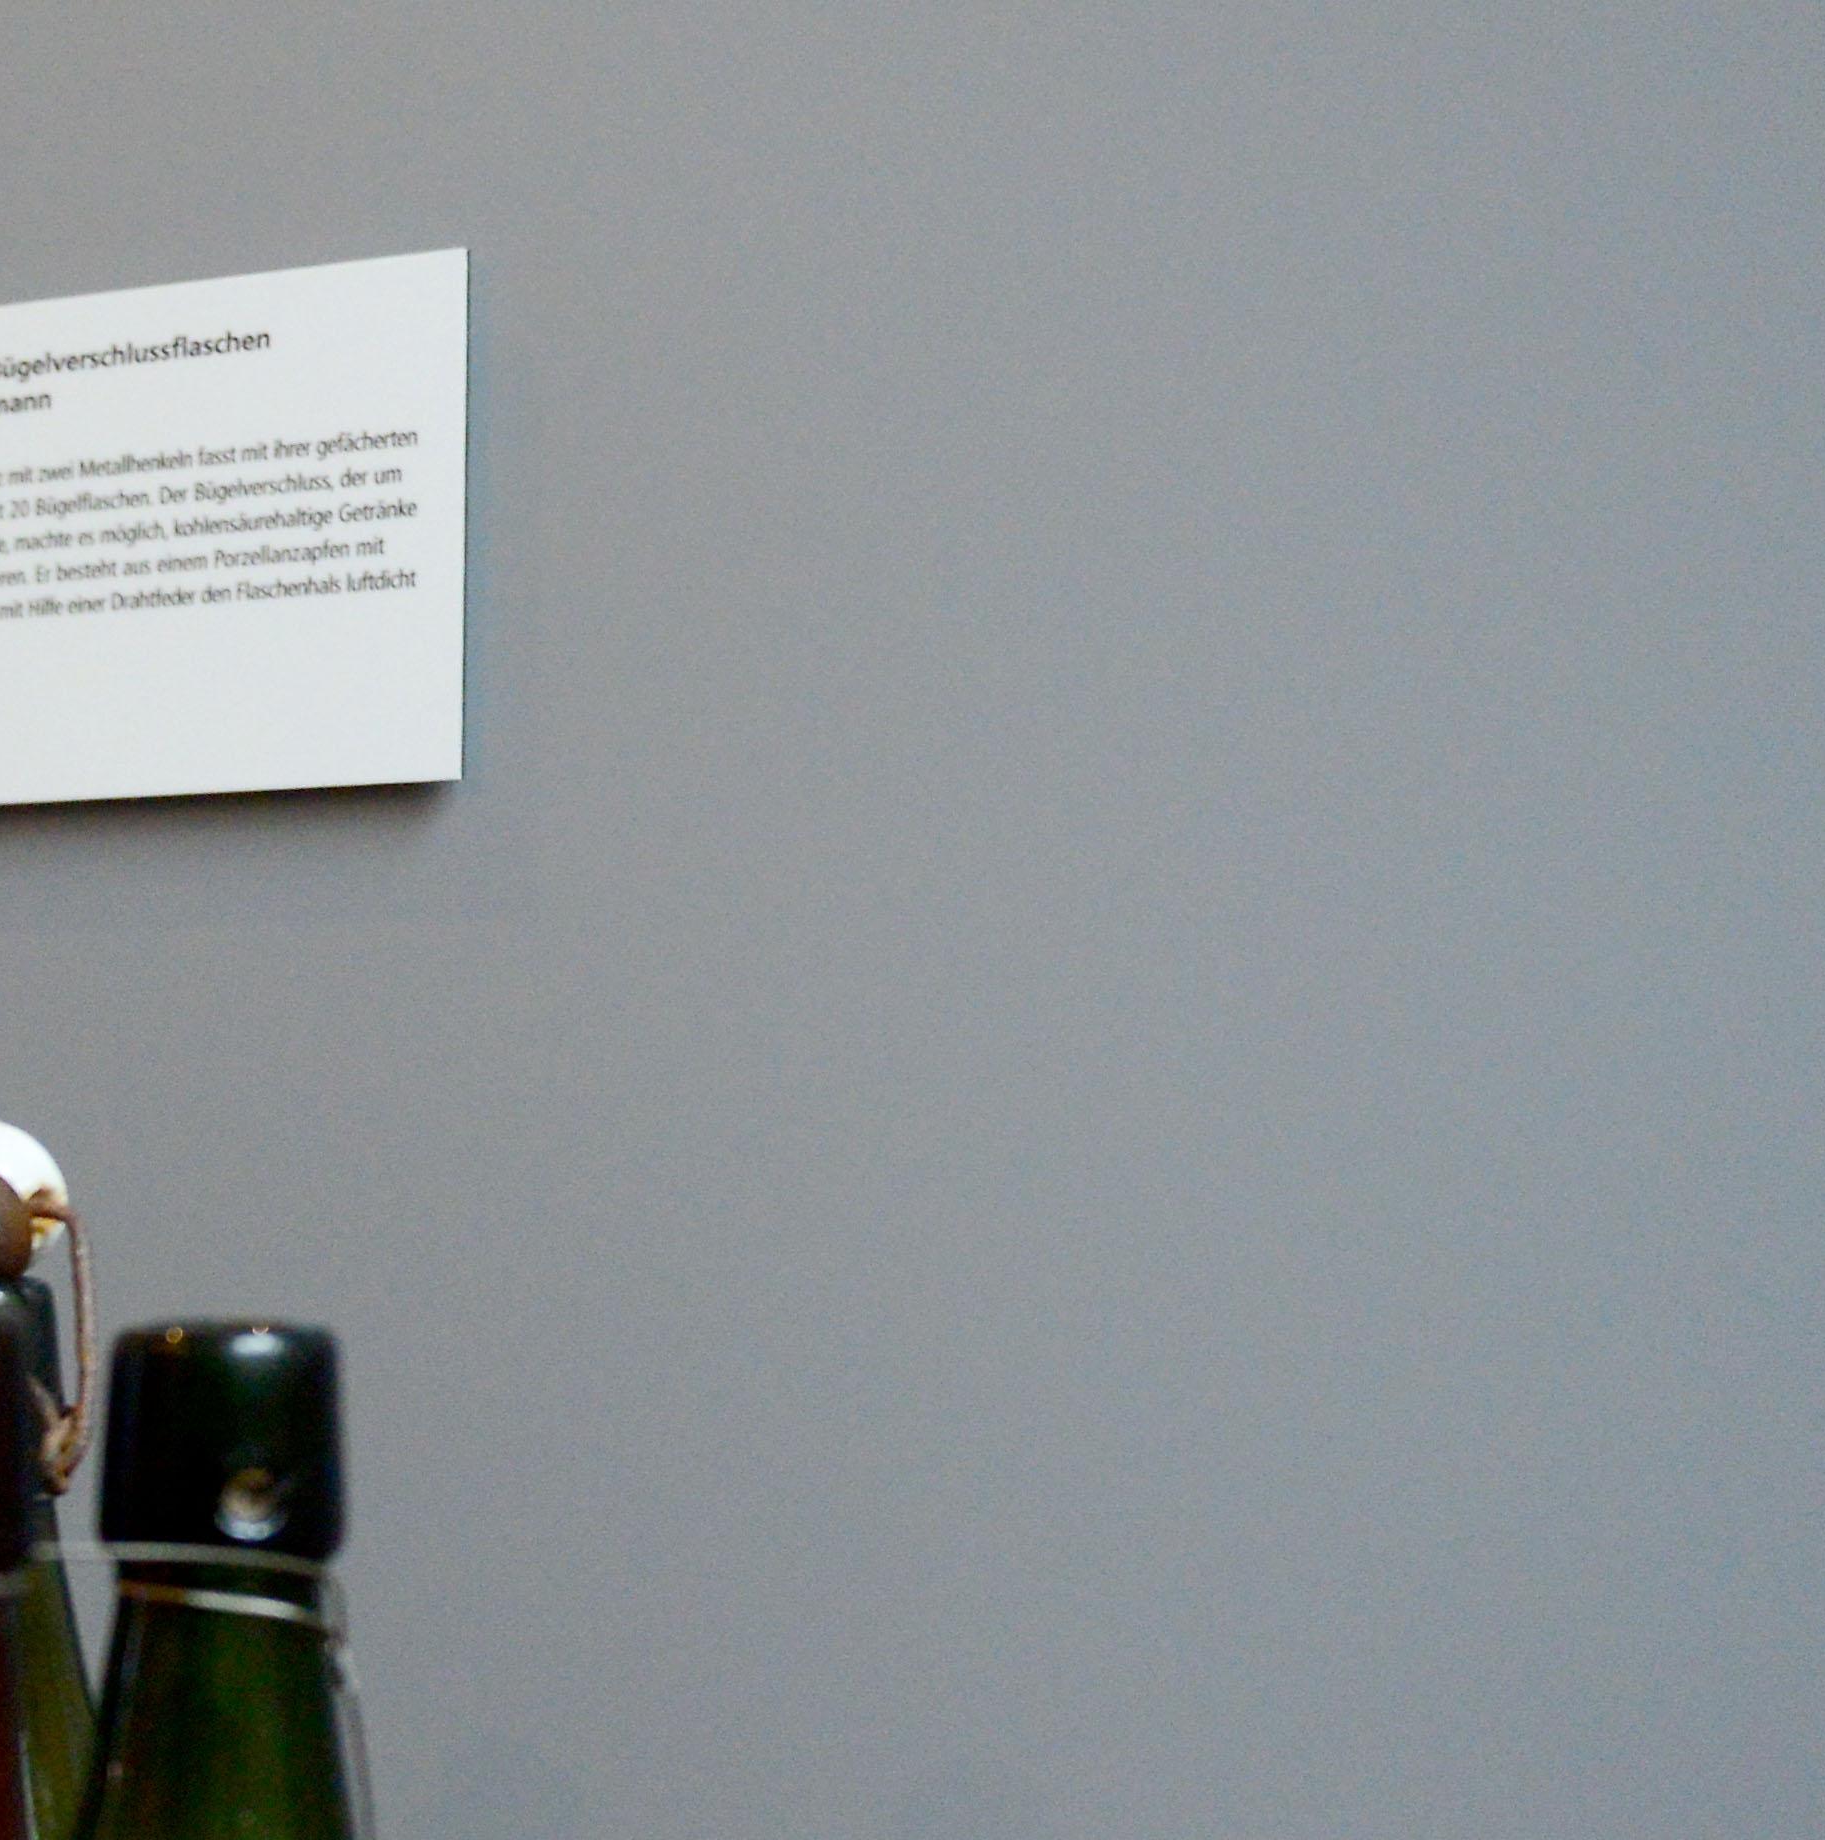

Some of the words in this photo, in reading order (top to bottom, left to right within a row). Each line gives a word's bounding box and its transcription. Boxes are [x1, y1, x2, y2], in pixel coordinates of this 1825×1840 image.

[8, 466, 32, 485] mit
[39, 463, 72, 482] zwei
[79, 449, 193, 478] Metallhenkeln
[198, 444, 235, 467] fasst
[242, 441, 268, 462] mit
[274, 438, 310, 459] ihrer
[317, 429, 418, 459] gefächerten
[10, 499, 29, 518] 20
[160, 486, 186, 505] Der
[340, 467, 366, 488] der
[375, 466, 402, 484] um
[15, 532, 71, 552] machte
[79, 532, 95, 546] es
[174, 509, 333, 537] kohlensäurehaltige
[340, 500, 417, 523] Getränke
[35, 565, 50, 584] Er
[56, 560, 116, 581] besteht
[123, 558, 150, 576] aus
[157, 552, 207, 572] einem
[214, 538, 349, 568] Porzellanzapfen
[356, 538, 383, 556] mit
[0, 602, 22, 619] mit
[29, 598, 62, 617] Hilfe
[69, 596, 104, 614] einer
[111, 584, 194, 610] Drahtfeder
[201, 582, 230, 602] den
[237, 575, 340, 601] Flaschenhals
[347, 569, 416, 592] luftdicht
